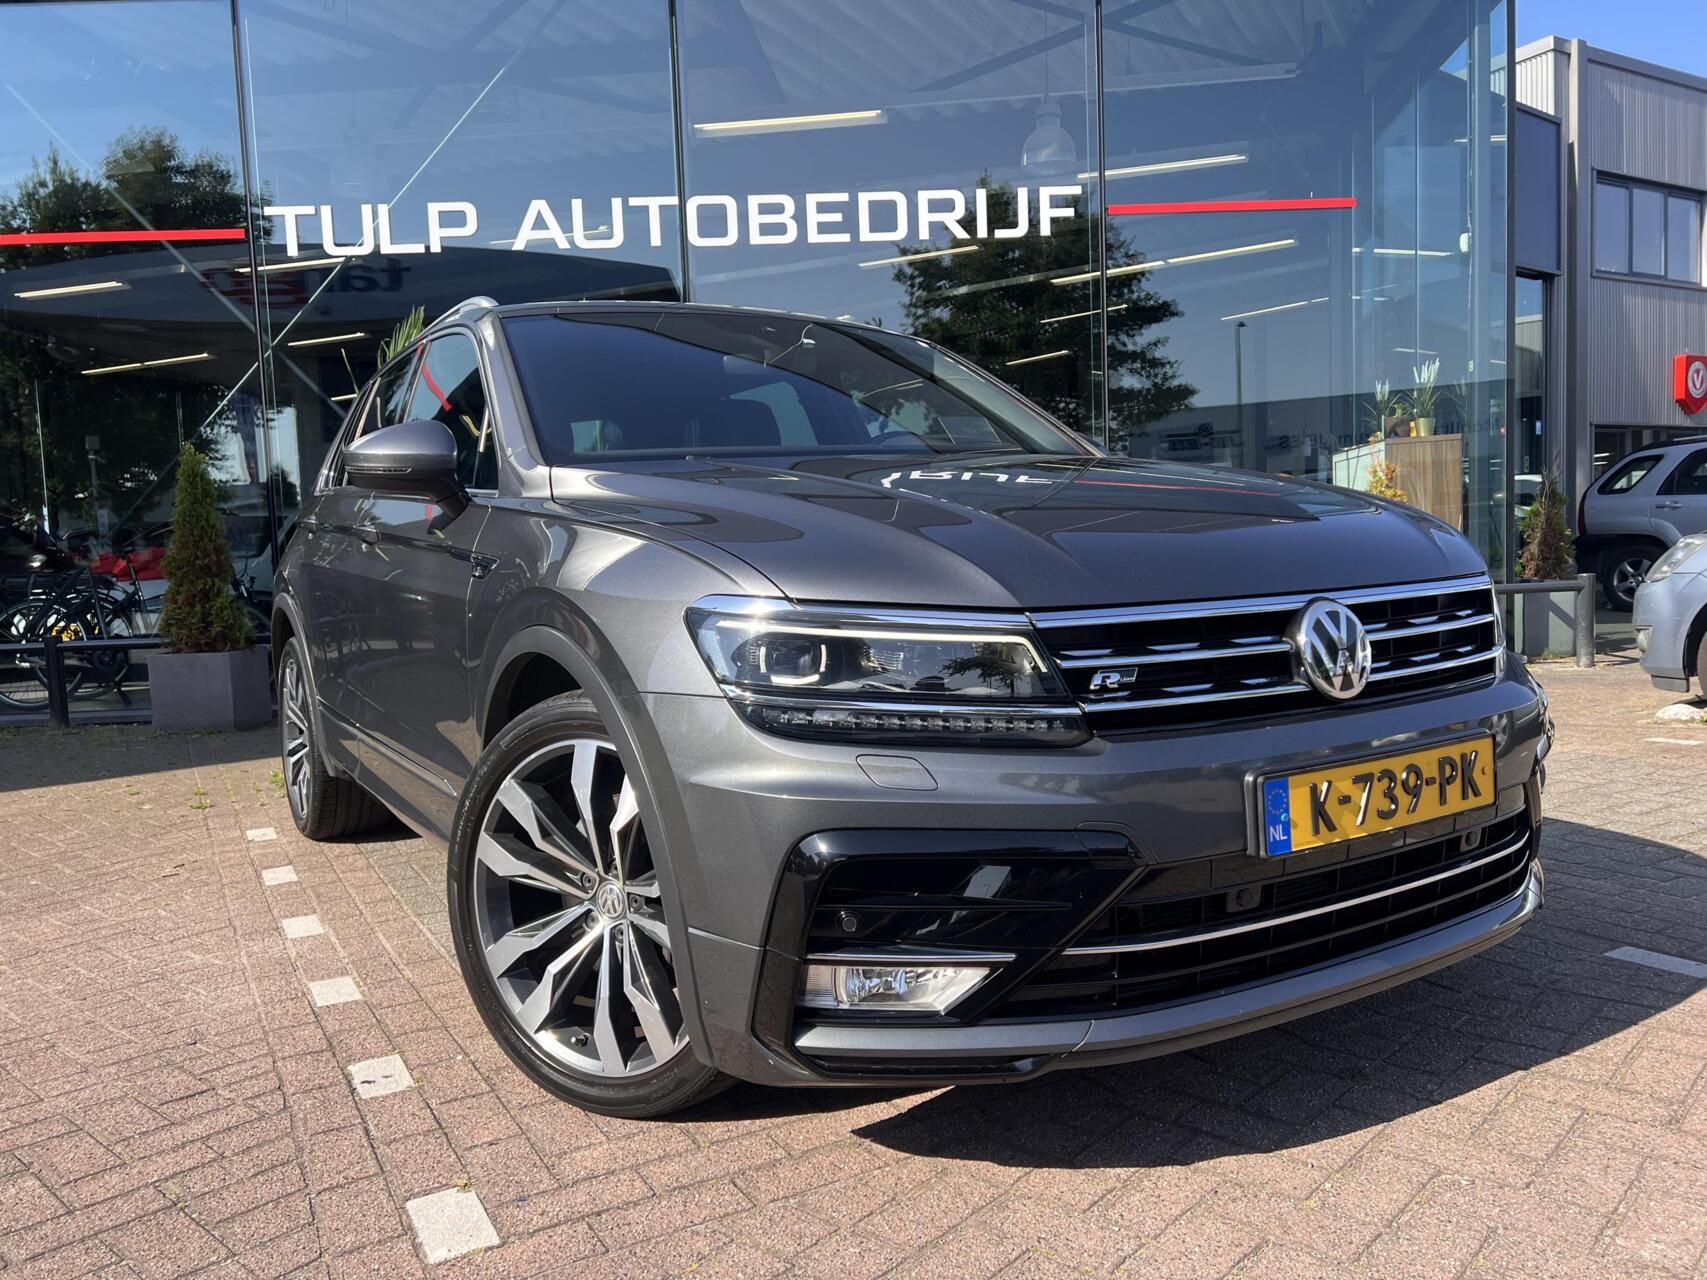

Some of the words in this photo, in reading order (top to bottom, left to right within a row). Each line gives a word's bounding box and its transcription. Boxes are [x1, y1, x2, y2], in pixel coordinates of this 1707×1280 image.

[263, 201, 478, 257] TULP
[511, 185, 1083, 251] AUTOBEDRIJF
[1309, 750, 1482, 837] K-739-PK
[1269, 826, 1288, 842] NL
